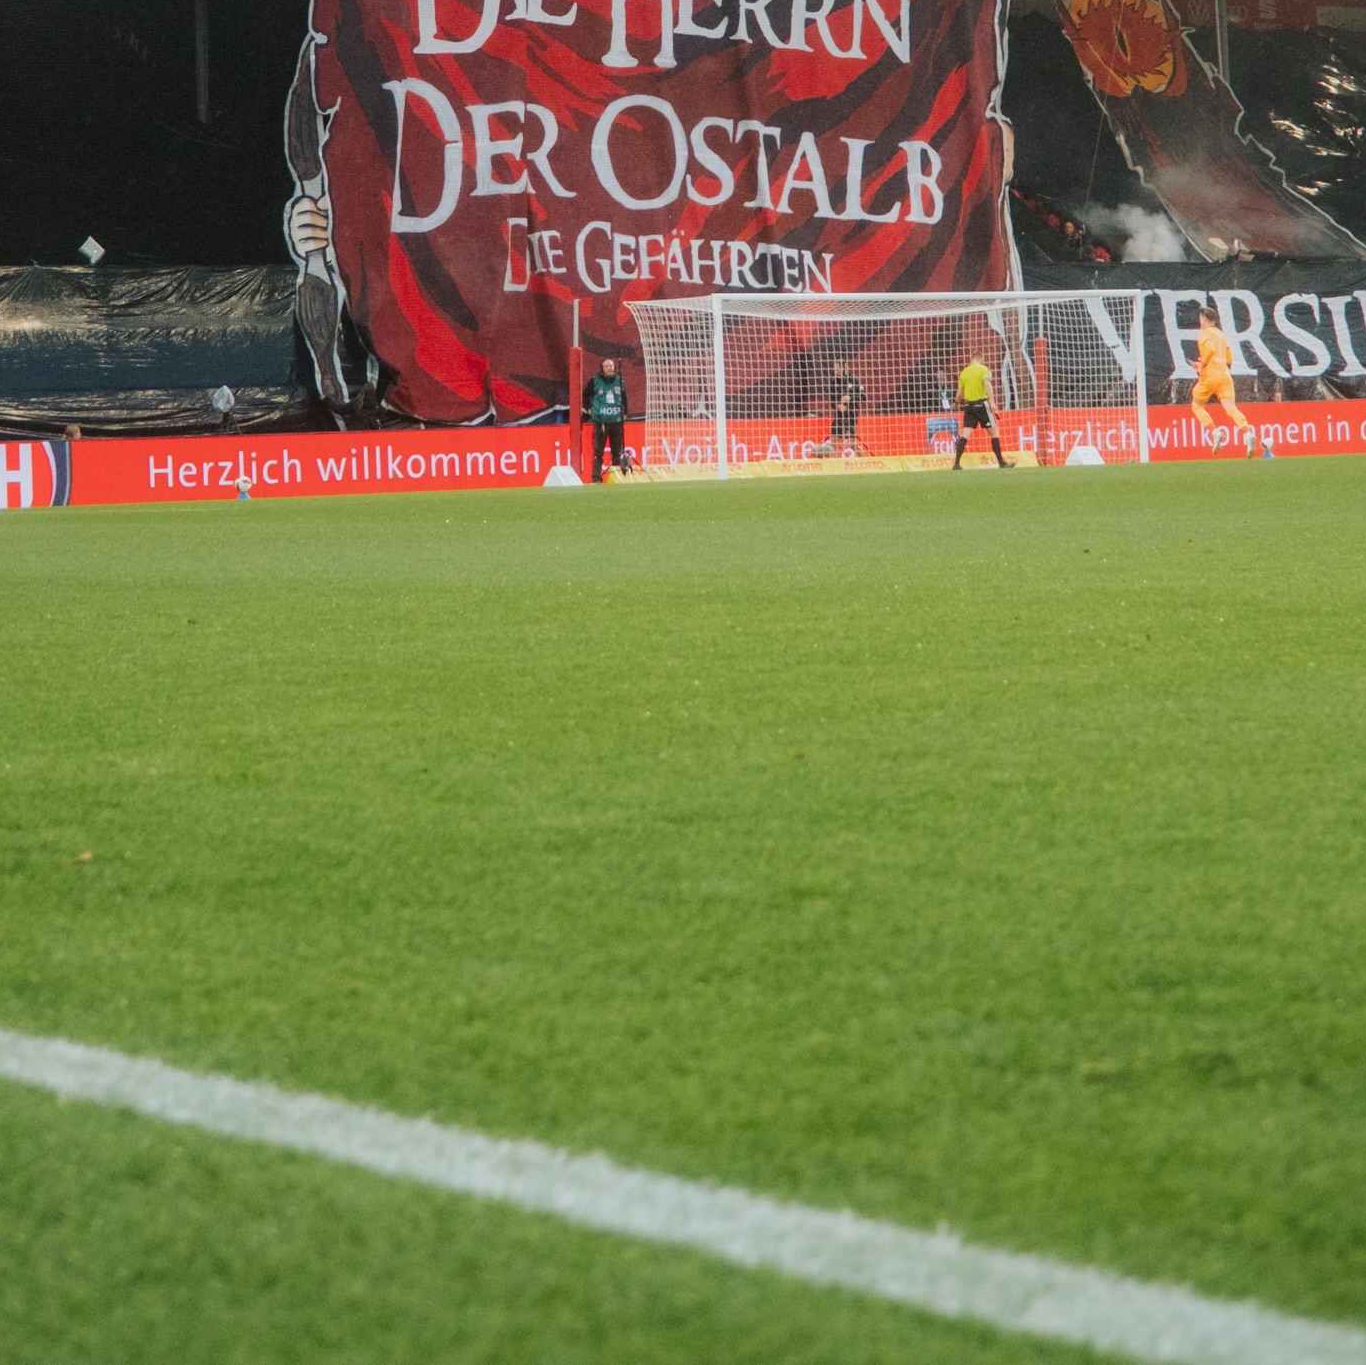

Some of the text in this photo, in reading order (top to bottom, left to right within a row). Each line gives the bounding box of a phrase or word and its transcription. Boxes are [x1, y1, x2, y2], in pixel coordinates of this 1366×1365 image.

[384, 74, 944, 235] DER OSTALB
[504, 217, 835, 294] DIE GEFÄHRTEN
[1327, 415, 1352, 443] in
[149, 448, 302, 488] Herzlich
[316, 442, 540, 483] willkommen
